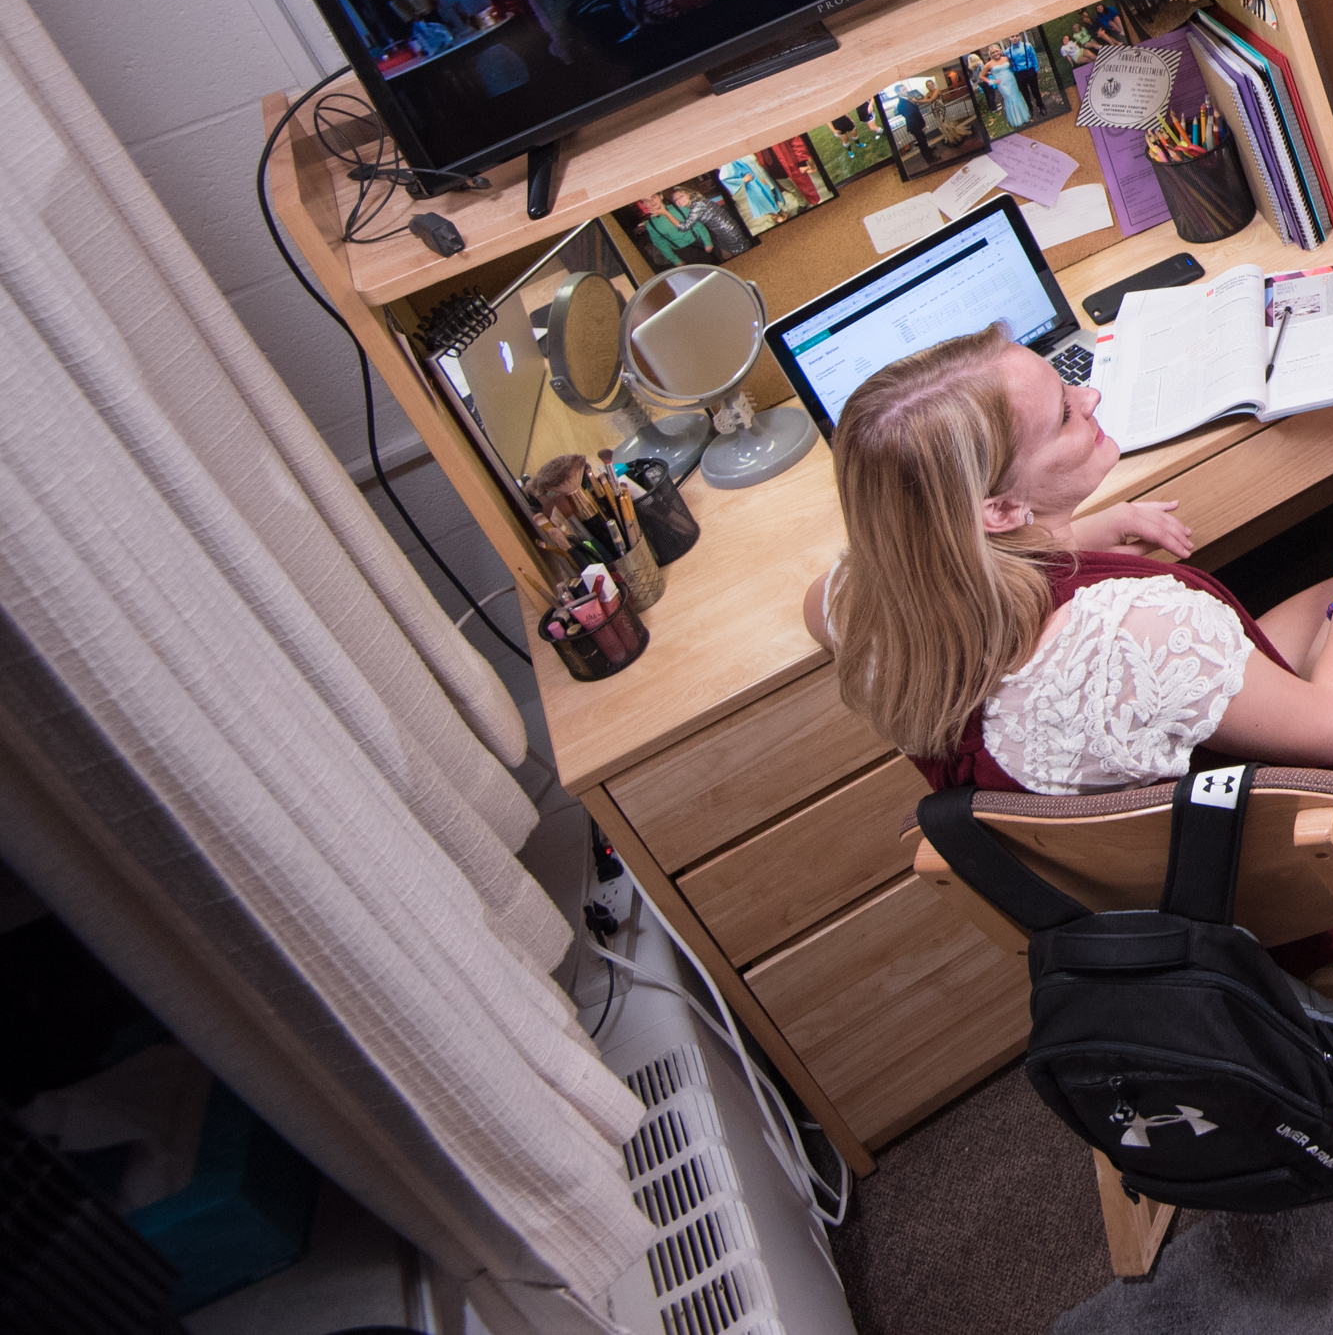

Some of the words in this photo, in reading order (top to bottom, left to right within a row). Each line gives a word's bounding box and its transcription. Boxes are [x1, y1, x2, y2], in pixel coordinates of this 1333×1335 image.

[1102, 64, 1127, 74] SORORITY
[1128, 65, 1167, 77] RECRUITMENT
[875, 203, 918, 227] Marissa
[880, 211, 932, 242] Swonger
